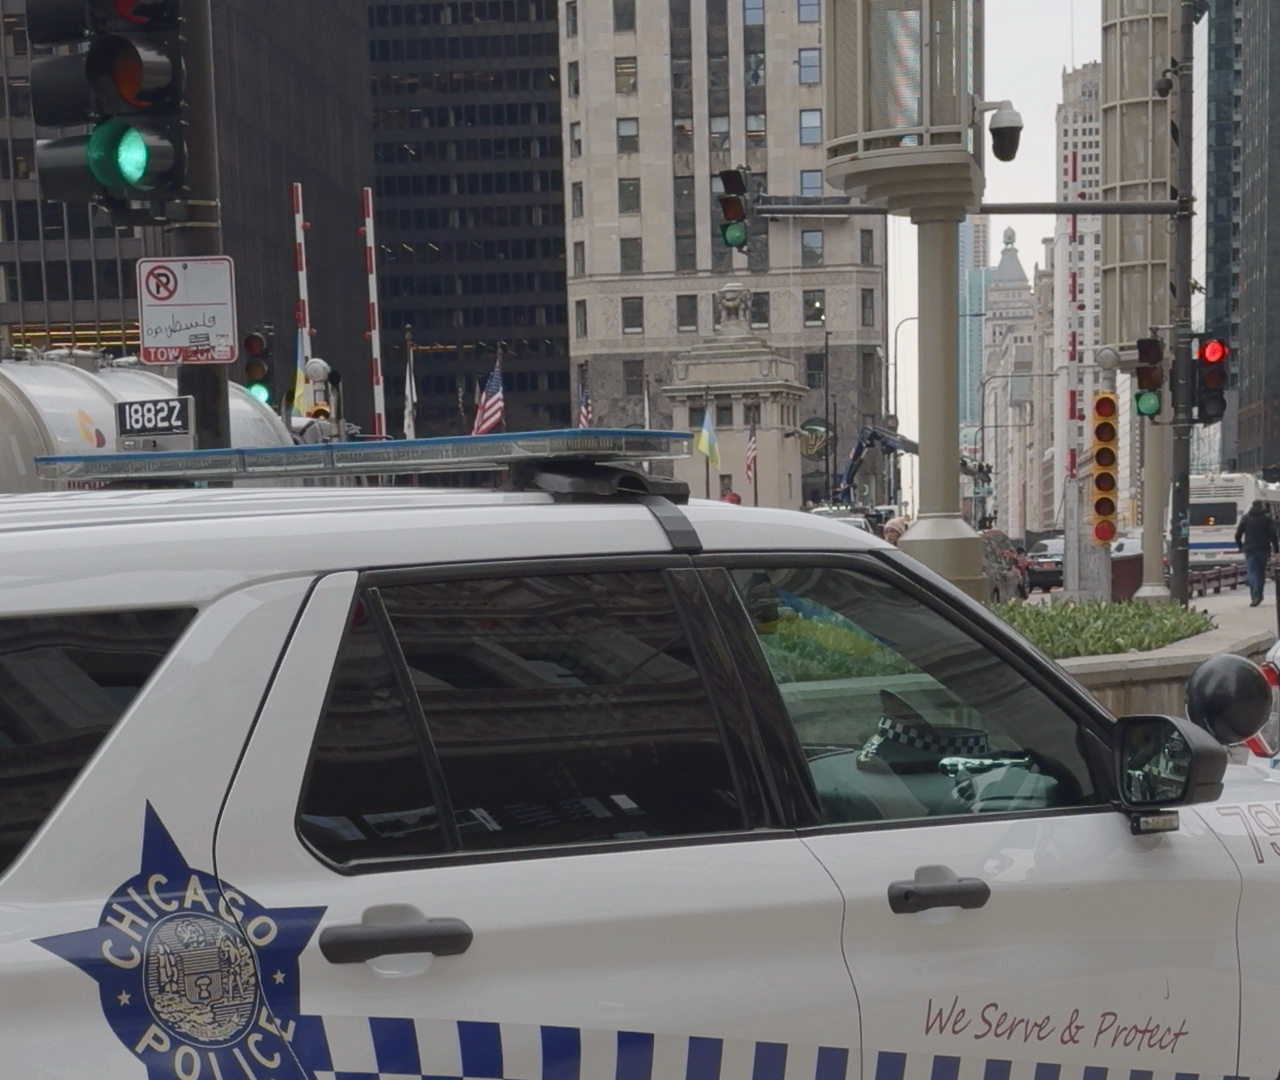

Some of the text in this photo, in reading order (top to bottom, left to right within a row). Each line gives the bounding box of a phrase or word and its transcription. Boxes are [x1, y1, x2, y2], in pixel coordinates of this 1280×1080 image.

[148, 347, 180, 361] TOW
[102, 873, 278, 969] CHICAGO
[924, 995, 1189, 1053] We Serve & Protect
